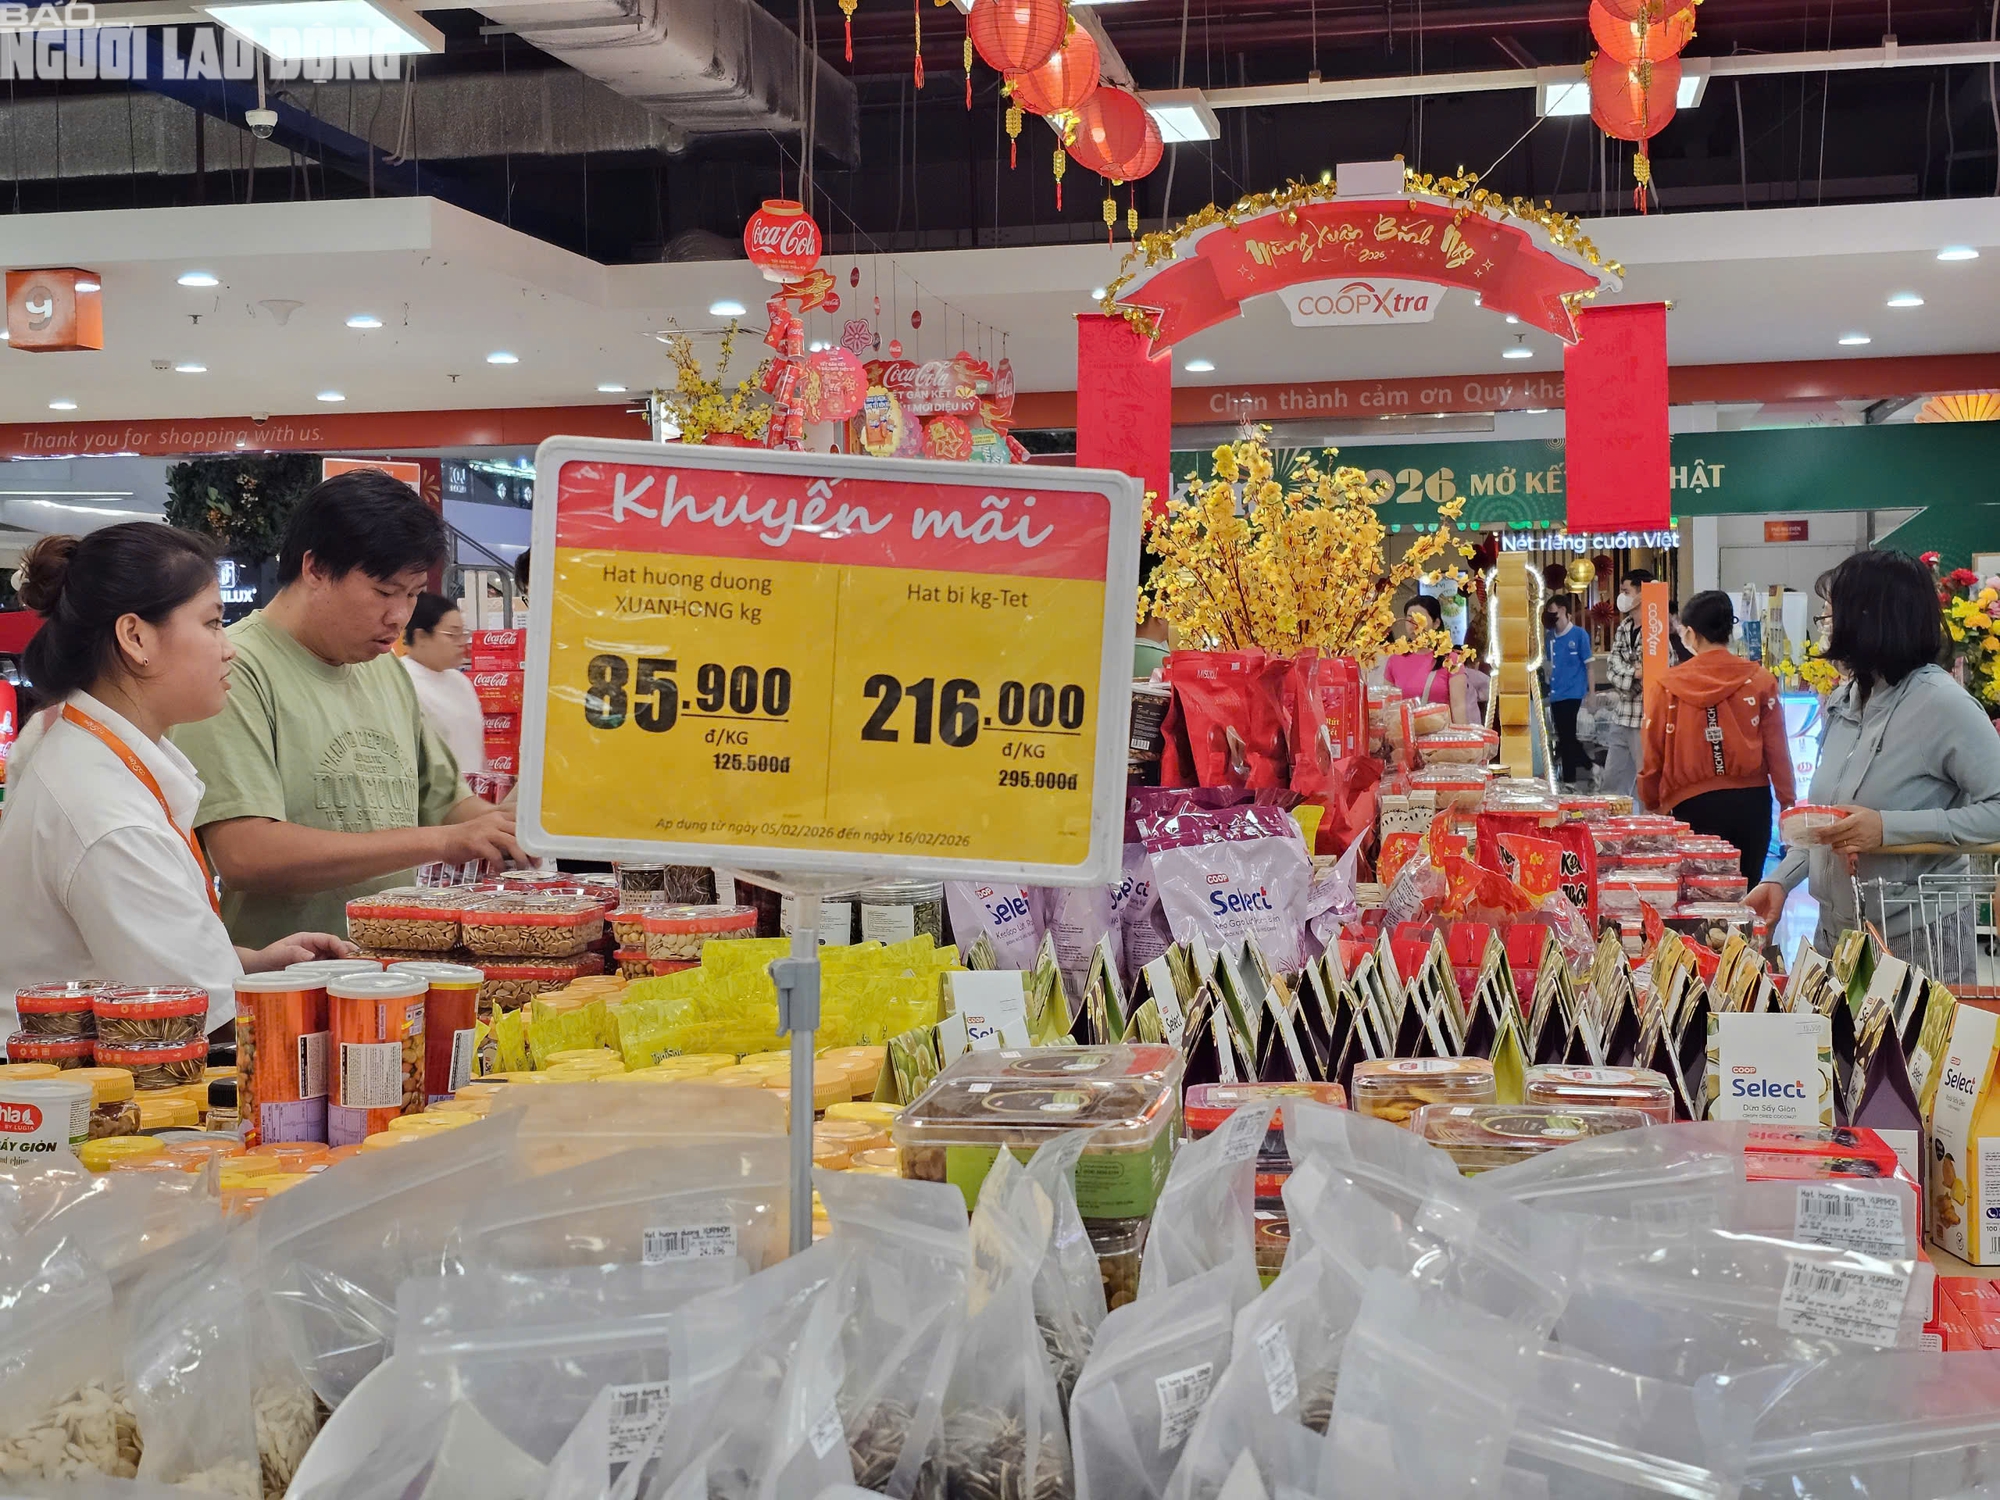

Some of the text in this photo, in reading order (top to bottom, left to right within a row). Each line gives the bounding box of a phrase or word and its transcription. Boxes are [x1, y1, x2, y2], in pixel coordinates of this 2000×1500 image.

[1358, 249, 1386, 262] 2026
[26, 286, 53, 331] 9
[883, 361, 951, 388] Coca-Cola
[1279, 387, 1347, 410] thành
[1360, 383, 1408, 407] cảm
[1420, 385, 1453, 404] ơn
[1463, 378, 1512, 407] Quý
[1524, 378, 1565, 400] khá
[22, 425, 325, 453] Thank you for shopping with us.
[1360, 459, 1726, 504] 026 MỞ KẾ HẬT
[612, 473, 1054, 549] Khuyến mãi
[1643, 531, 1680, 551] Việt
[603, 565, 772, 596] Hat huong duong
[907, 583, 1029, 609] Hat bi kg-Tet
[615, 595, 762, 625] XUANHONG kg
[484, 632, 518, 646] Coca-Cola
[474, 673, 509, 687] Coca-Cola
[585, 653, 791, 733] 85.900
[861, 674, 1085, 748] 216.000
[704, 728, 749, 746] đ/KG
[713, 752, 790, 774] 125.500đ
[1002, 741, 1046, 760] đ/KG
[998, 769, 1078, 791] 295.000đ
[761, 822, 834, 840] 05/02/2026
[897, 831, 970, 848] 16/02/2026
[1207, 874, 1228, 885] COOP
[1210, 886, 1272, 916] Select
[1732, 1066, 1757, 1074] COOP
[1945, 1068, 1976, 1095] Select
[1732, 1078, 1806, 1099] Select
[0, 1137, 18, 1151] ẤY
